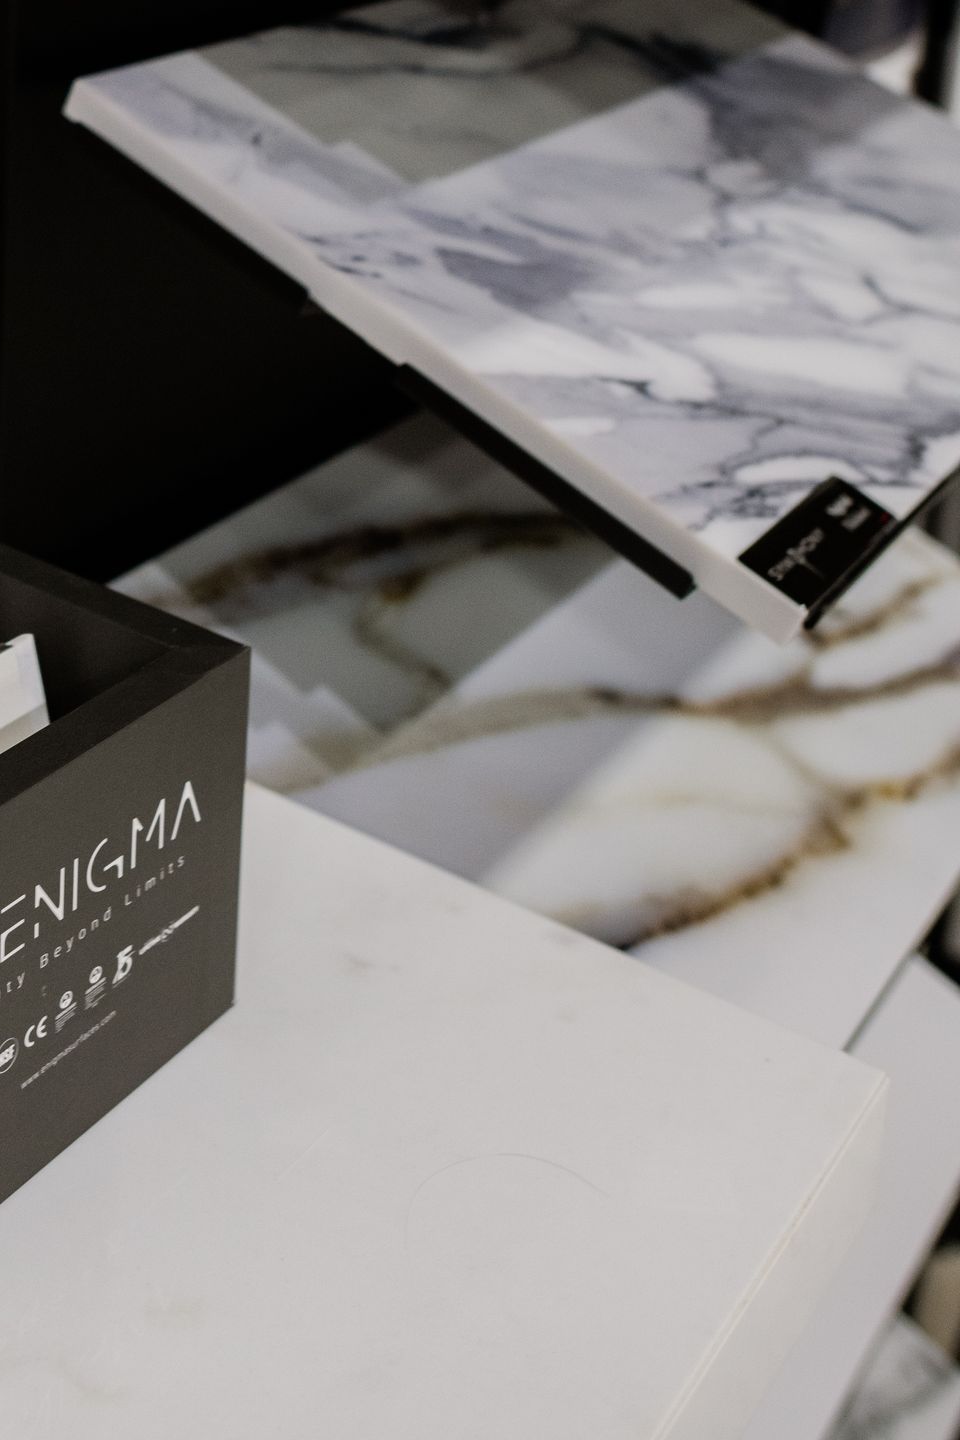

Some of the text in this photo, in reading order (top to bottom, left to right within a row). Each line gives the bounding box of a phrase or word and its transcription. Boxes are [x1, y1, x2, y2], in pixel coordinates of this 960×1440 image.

[0, 780, 201, 964] ENIGMA
[40, 906, 112, 969] Beyond
[124, 855, 185, 906] Limits
[24, 1015, 48, 1048] CE
